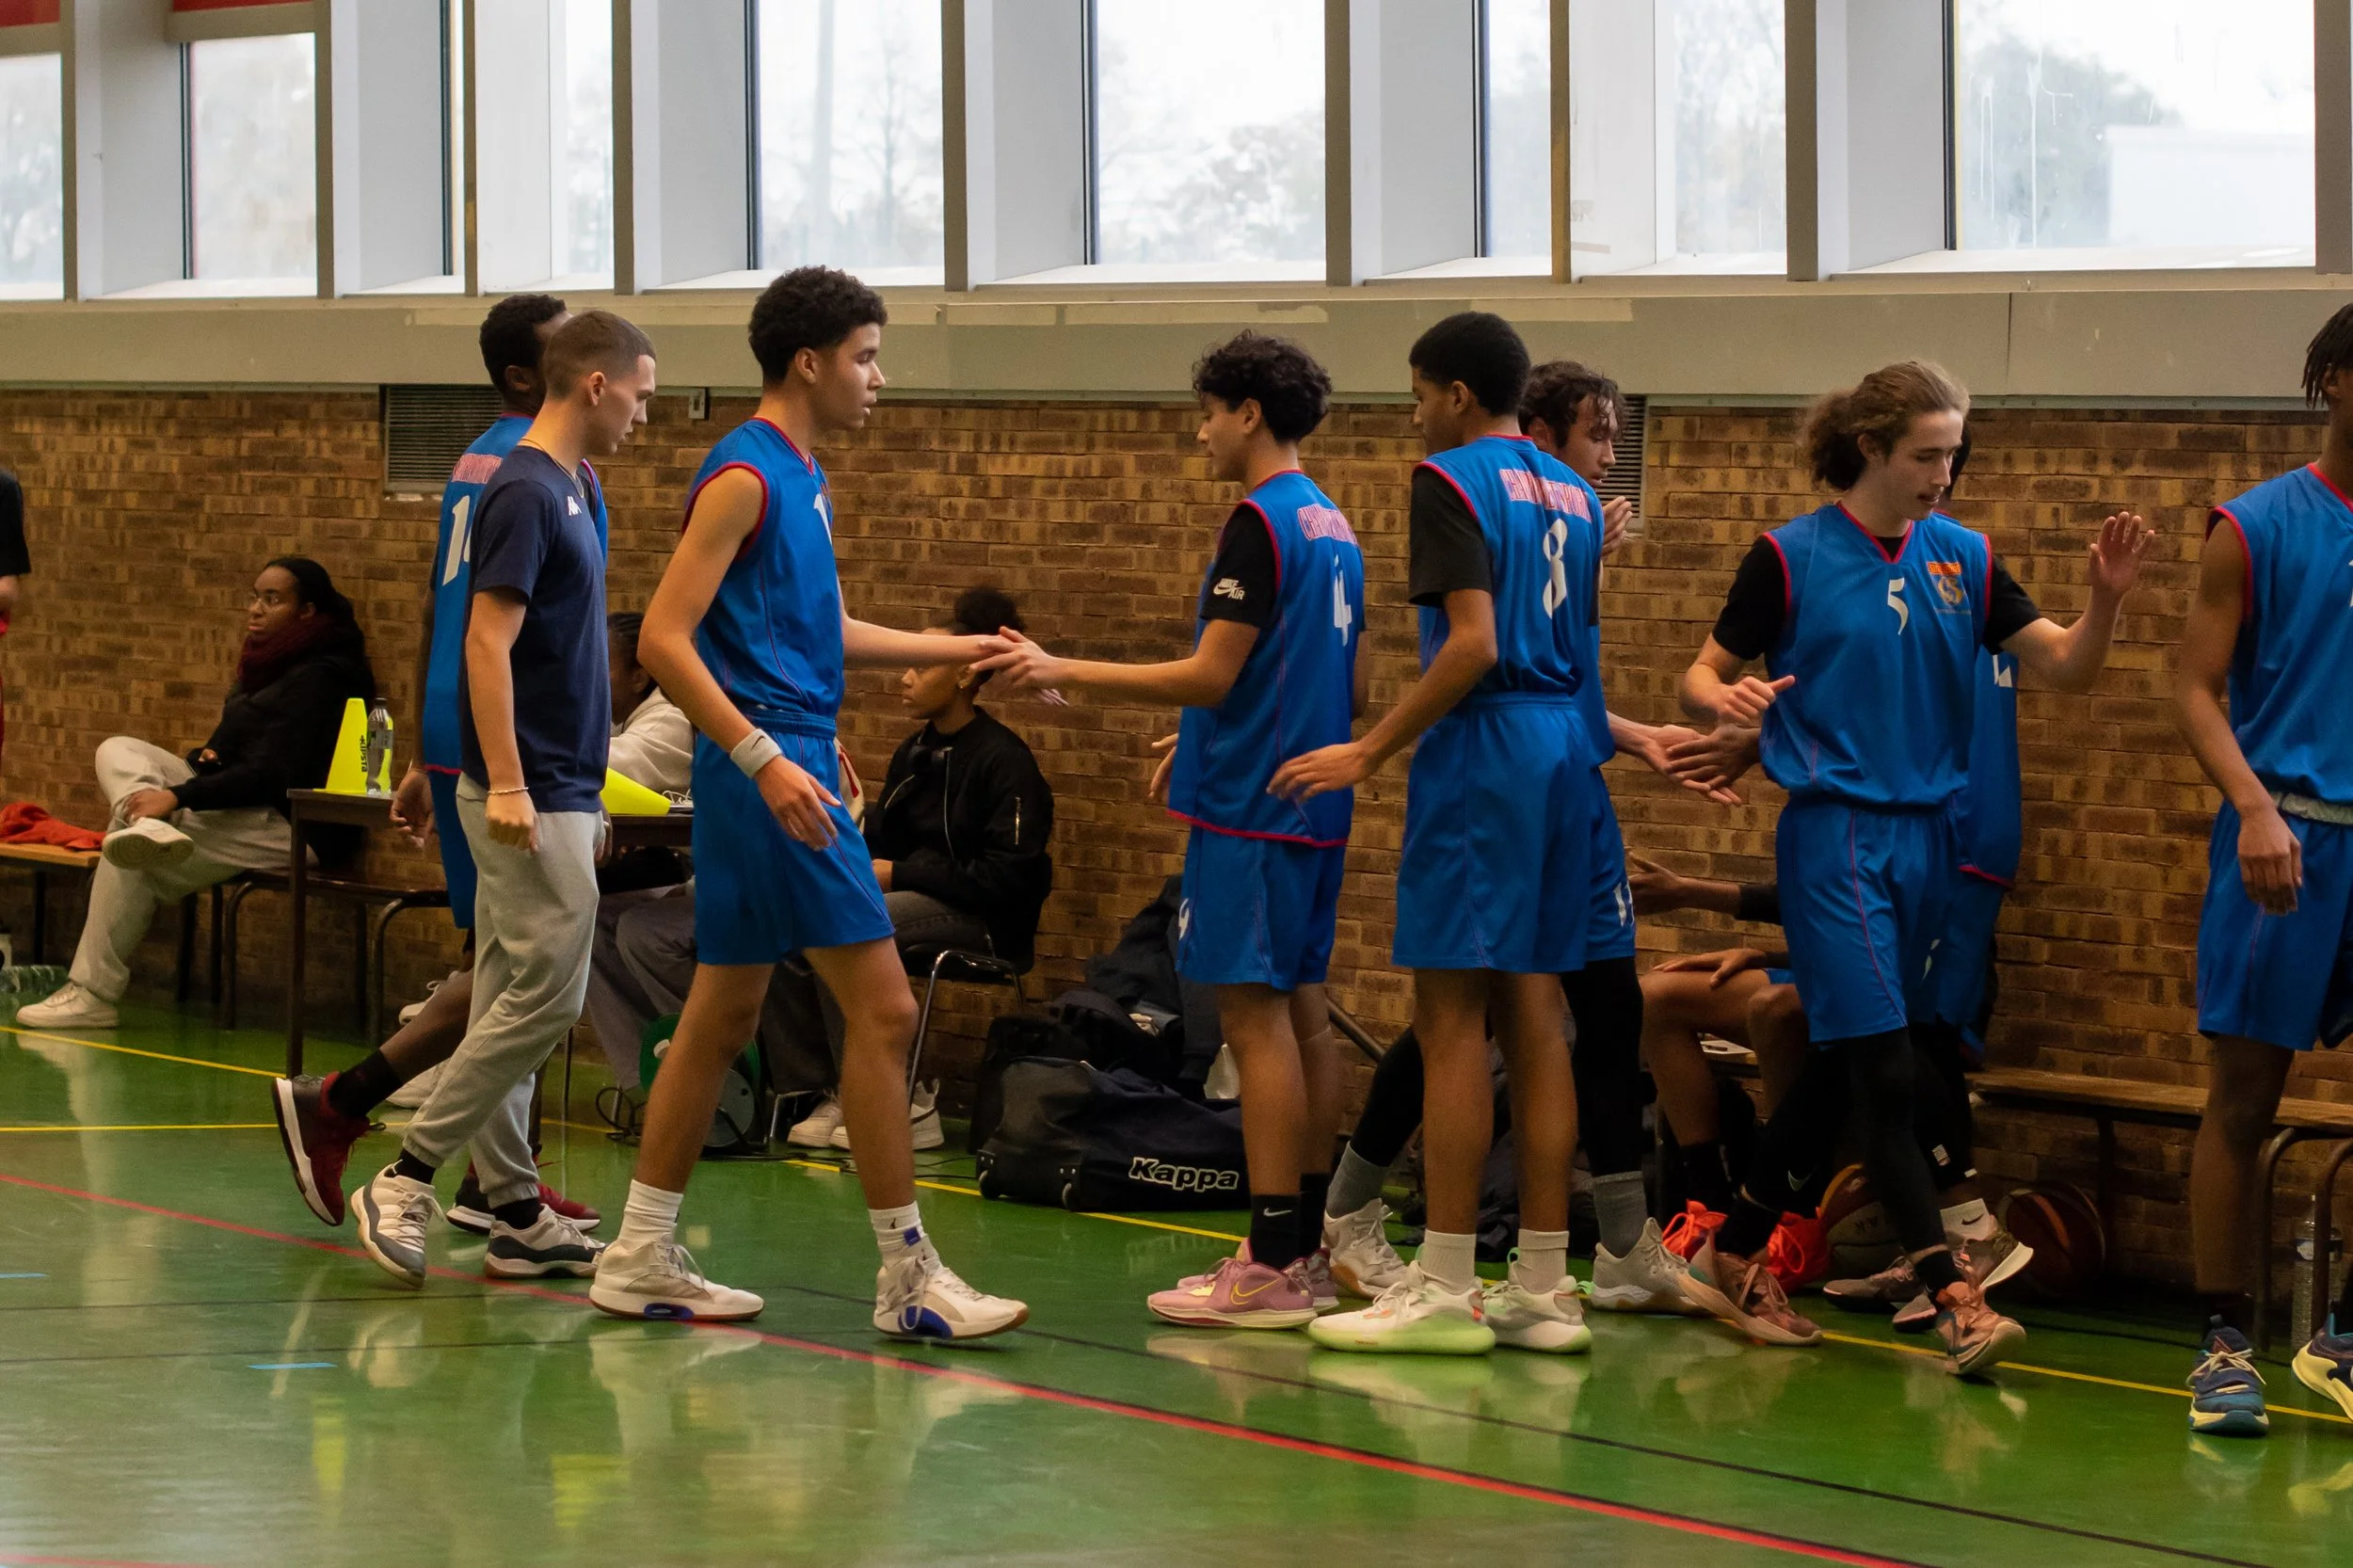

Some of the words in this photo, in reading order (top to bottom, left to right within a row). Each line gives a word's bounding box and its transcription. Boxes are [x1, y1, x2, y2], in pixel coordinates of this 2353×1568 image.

[1227, 588, 1244, 600] AIR
[1543, 518, 1568, 620] 8
[1333, 553, 1353, 647] 4
[1886, 576, 1910, 636] 5
[1128, 1157, 1240, 1192] Kappa
